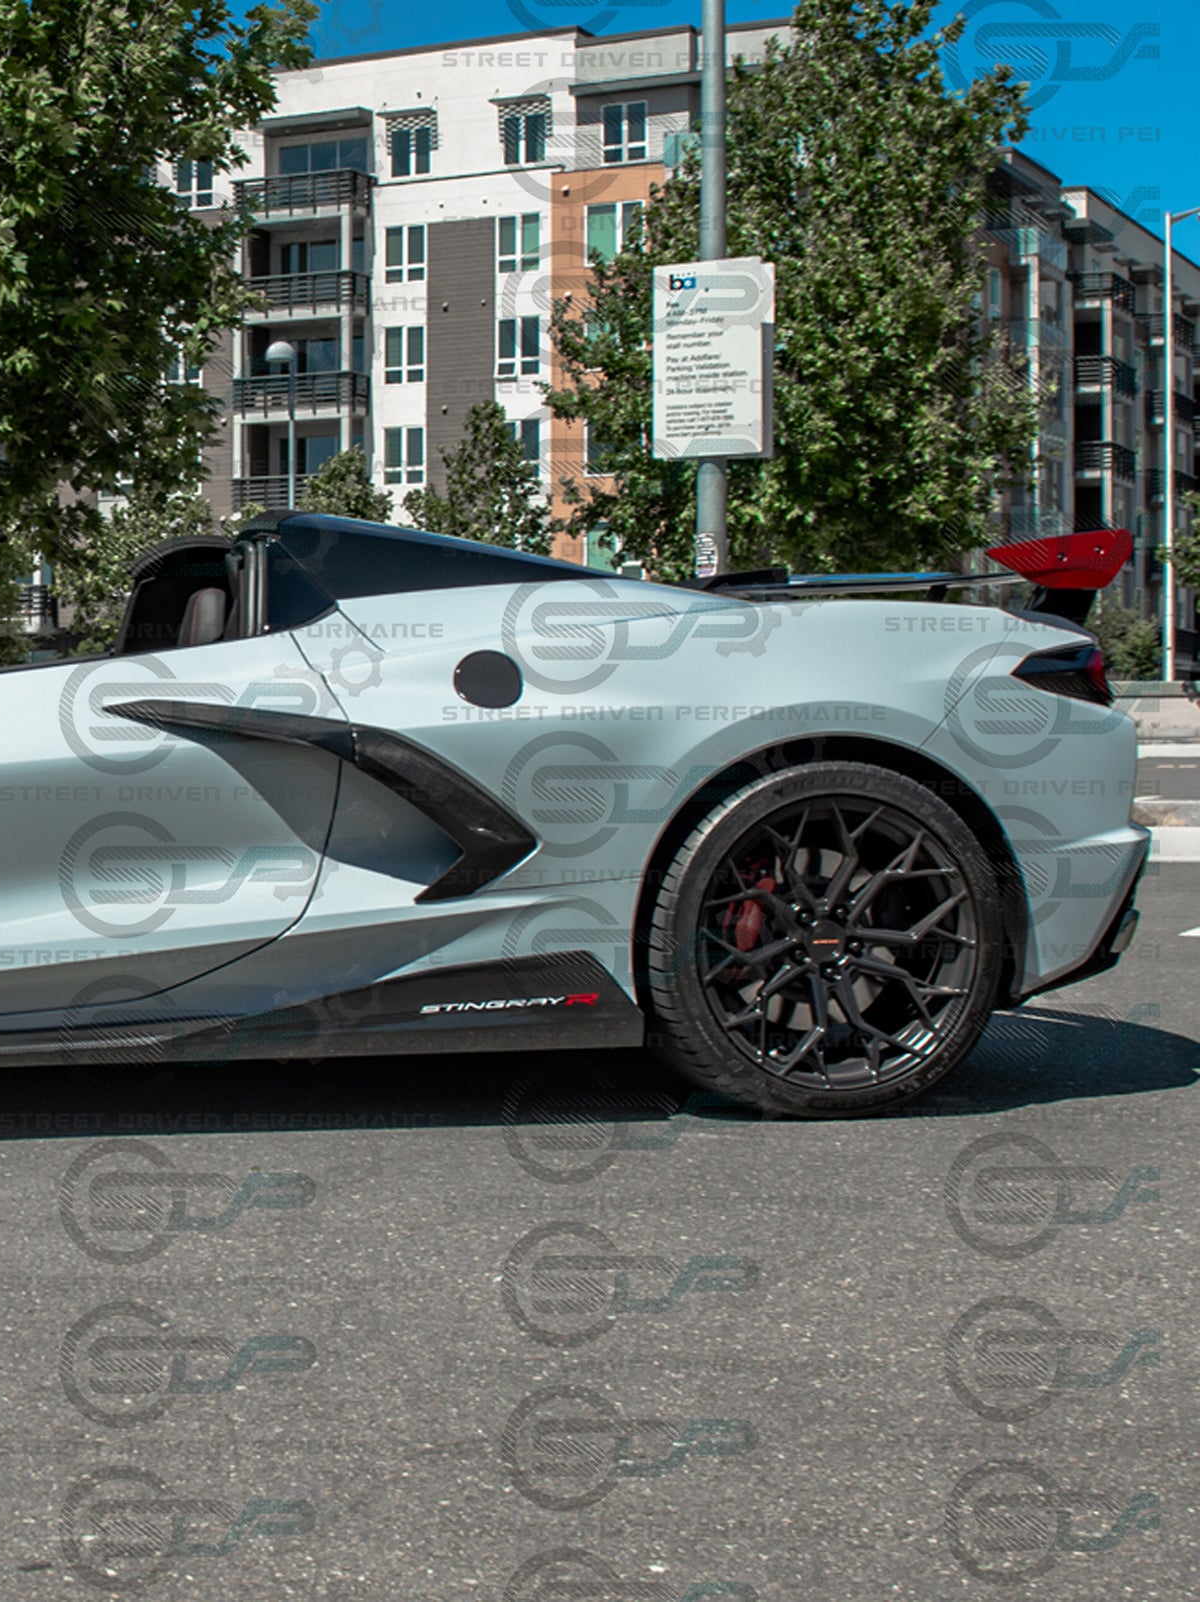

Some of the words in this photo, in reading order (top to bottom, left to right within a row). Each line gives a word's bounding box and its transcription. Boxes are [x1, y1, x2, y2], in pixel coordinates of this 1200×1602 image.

[666, 331, 706, 340] Remember
[708, 330, 724, 339] your
[666, 355, 680, 364] Pay
[666, 365, 693, 373] Parking
[695, 362, 731, 370] Validation
[666, 373, 697, 381] machine
[699, 371, 720, 379] inside
[419, 996, 565, 1015] STINGRAY
